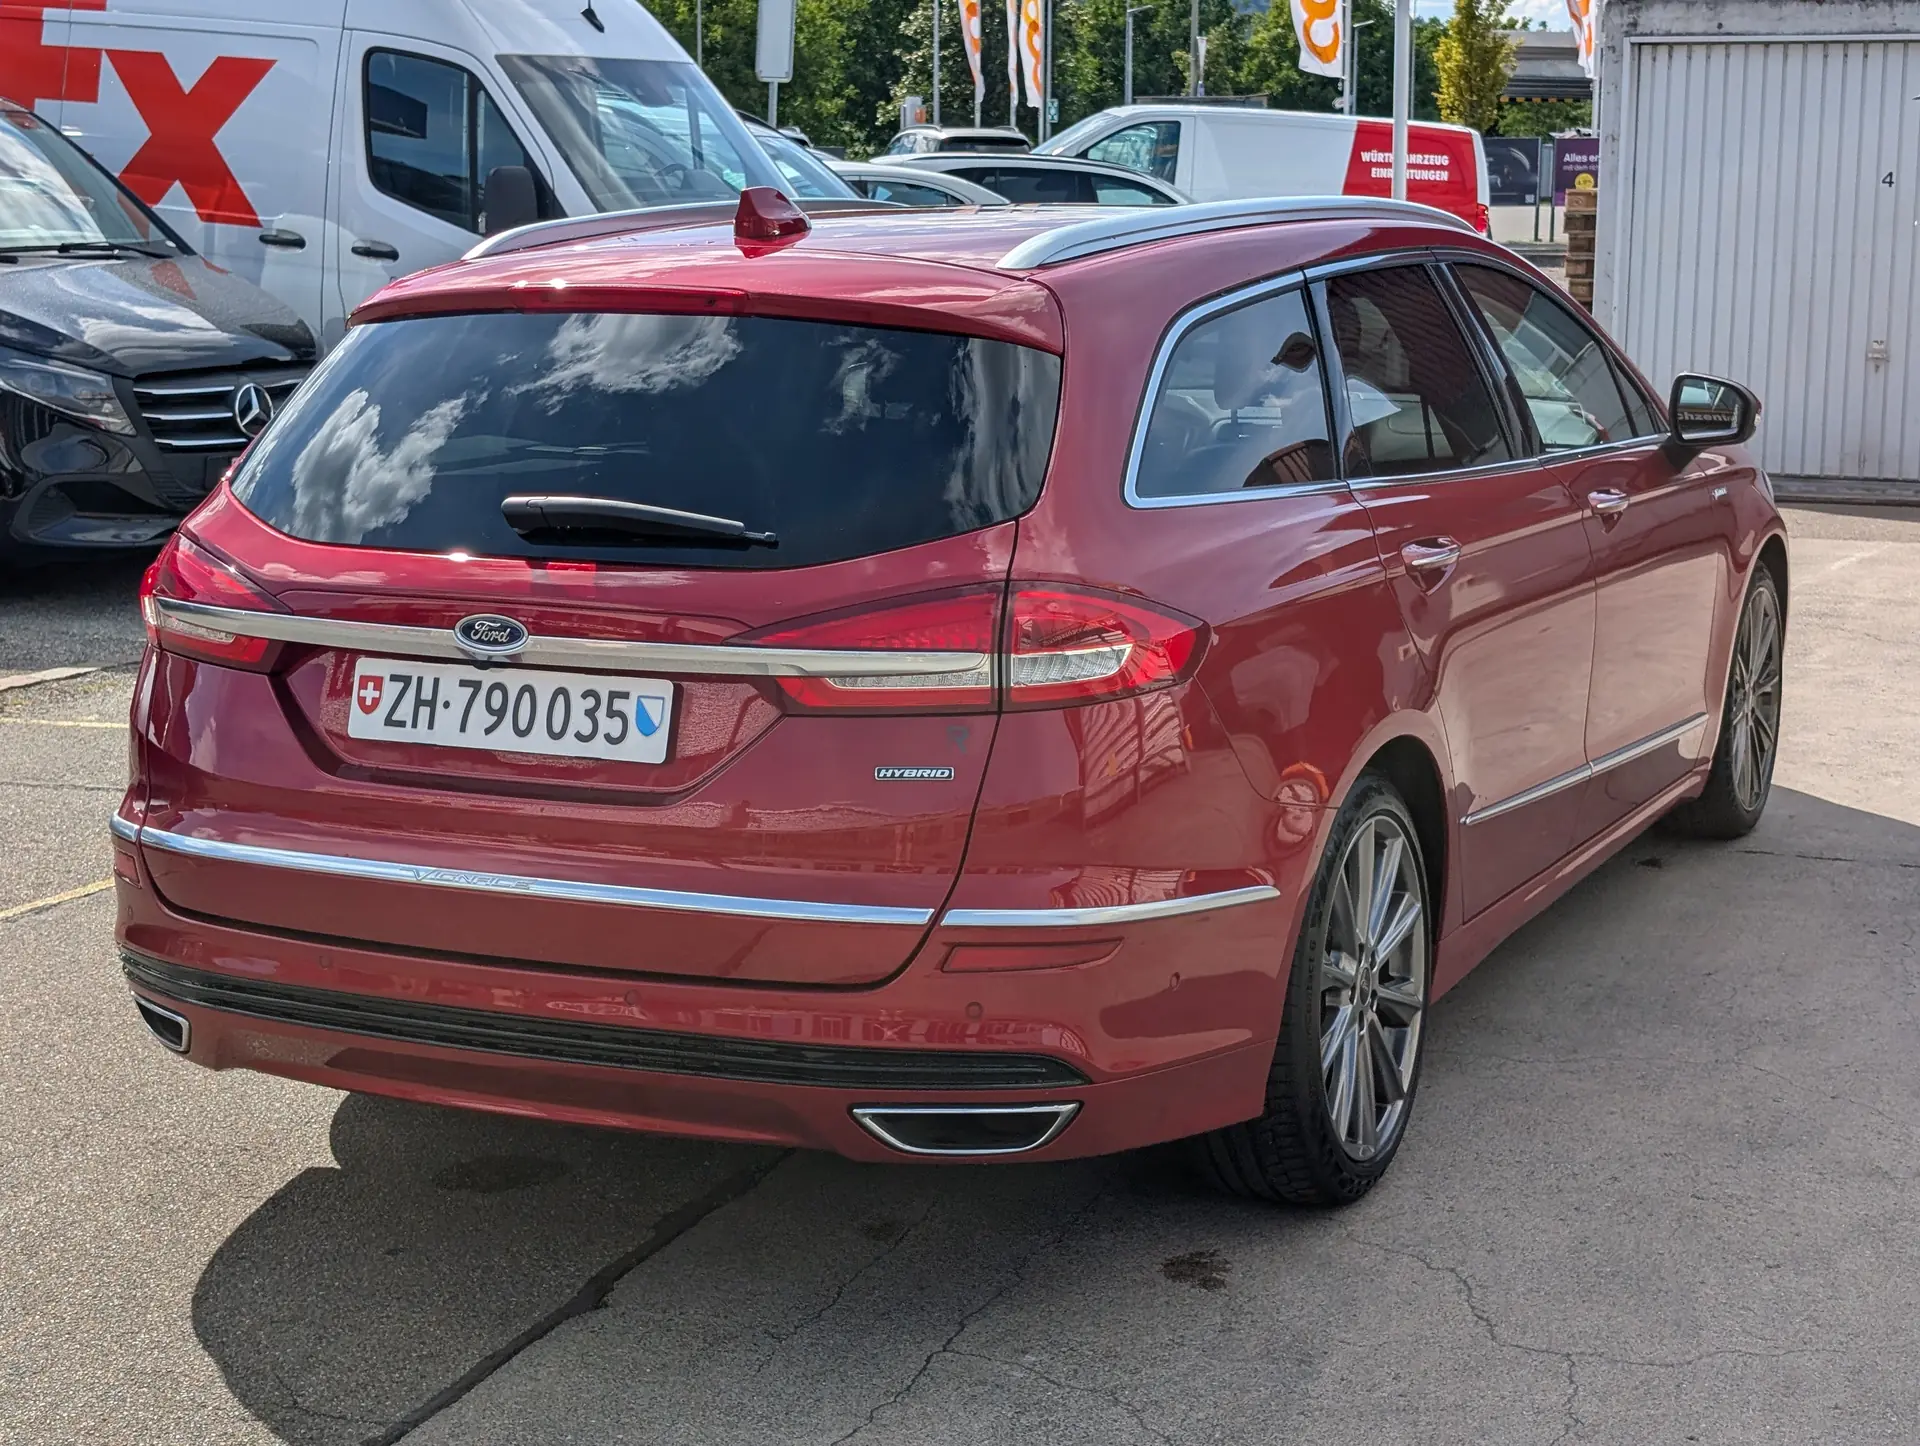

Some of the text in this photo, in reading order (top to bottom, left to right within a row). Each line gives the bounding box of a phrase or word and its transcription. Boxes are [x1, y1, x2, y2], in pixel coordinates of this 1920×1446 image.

[1563, 153, 1585, 163] Alles
[1881, 171, 1895, 188] 4
[470, 620, 509, 643] Ford
[879, 769, 950, 778] HYBRID
